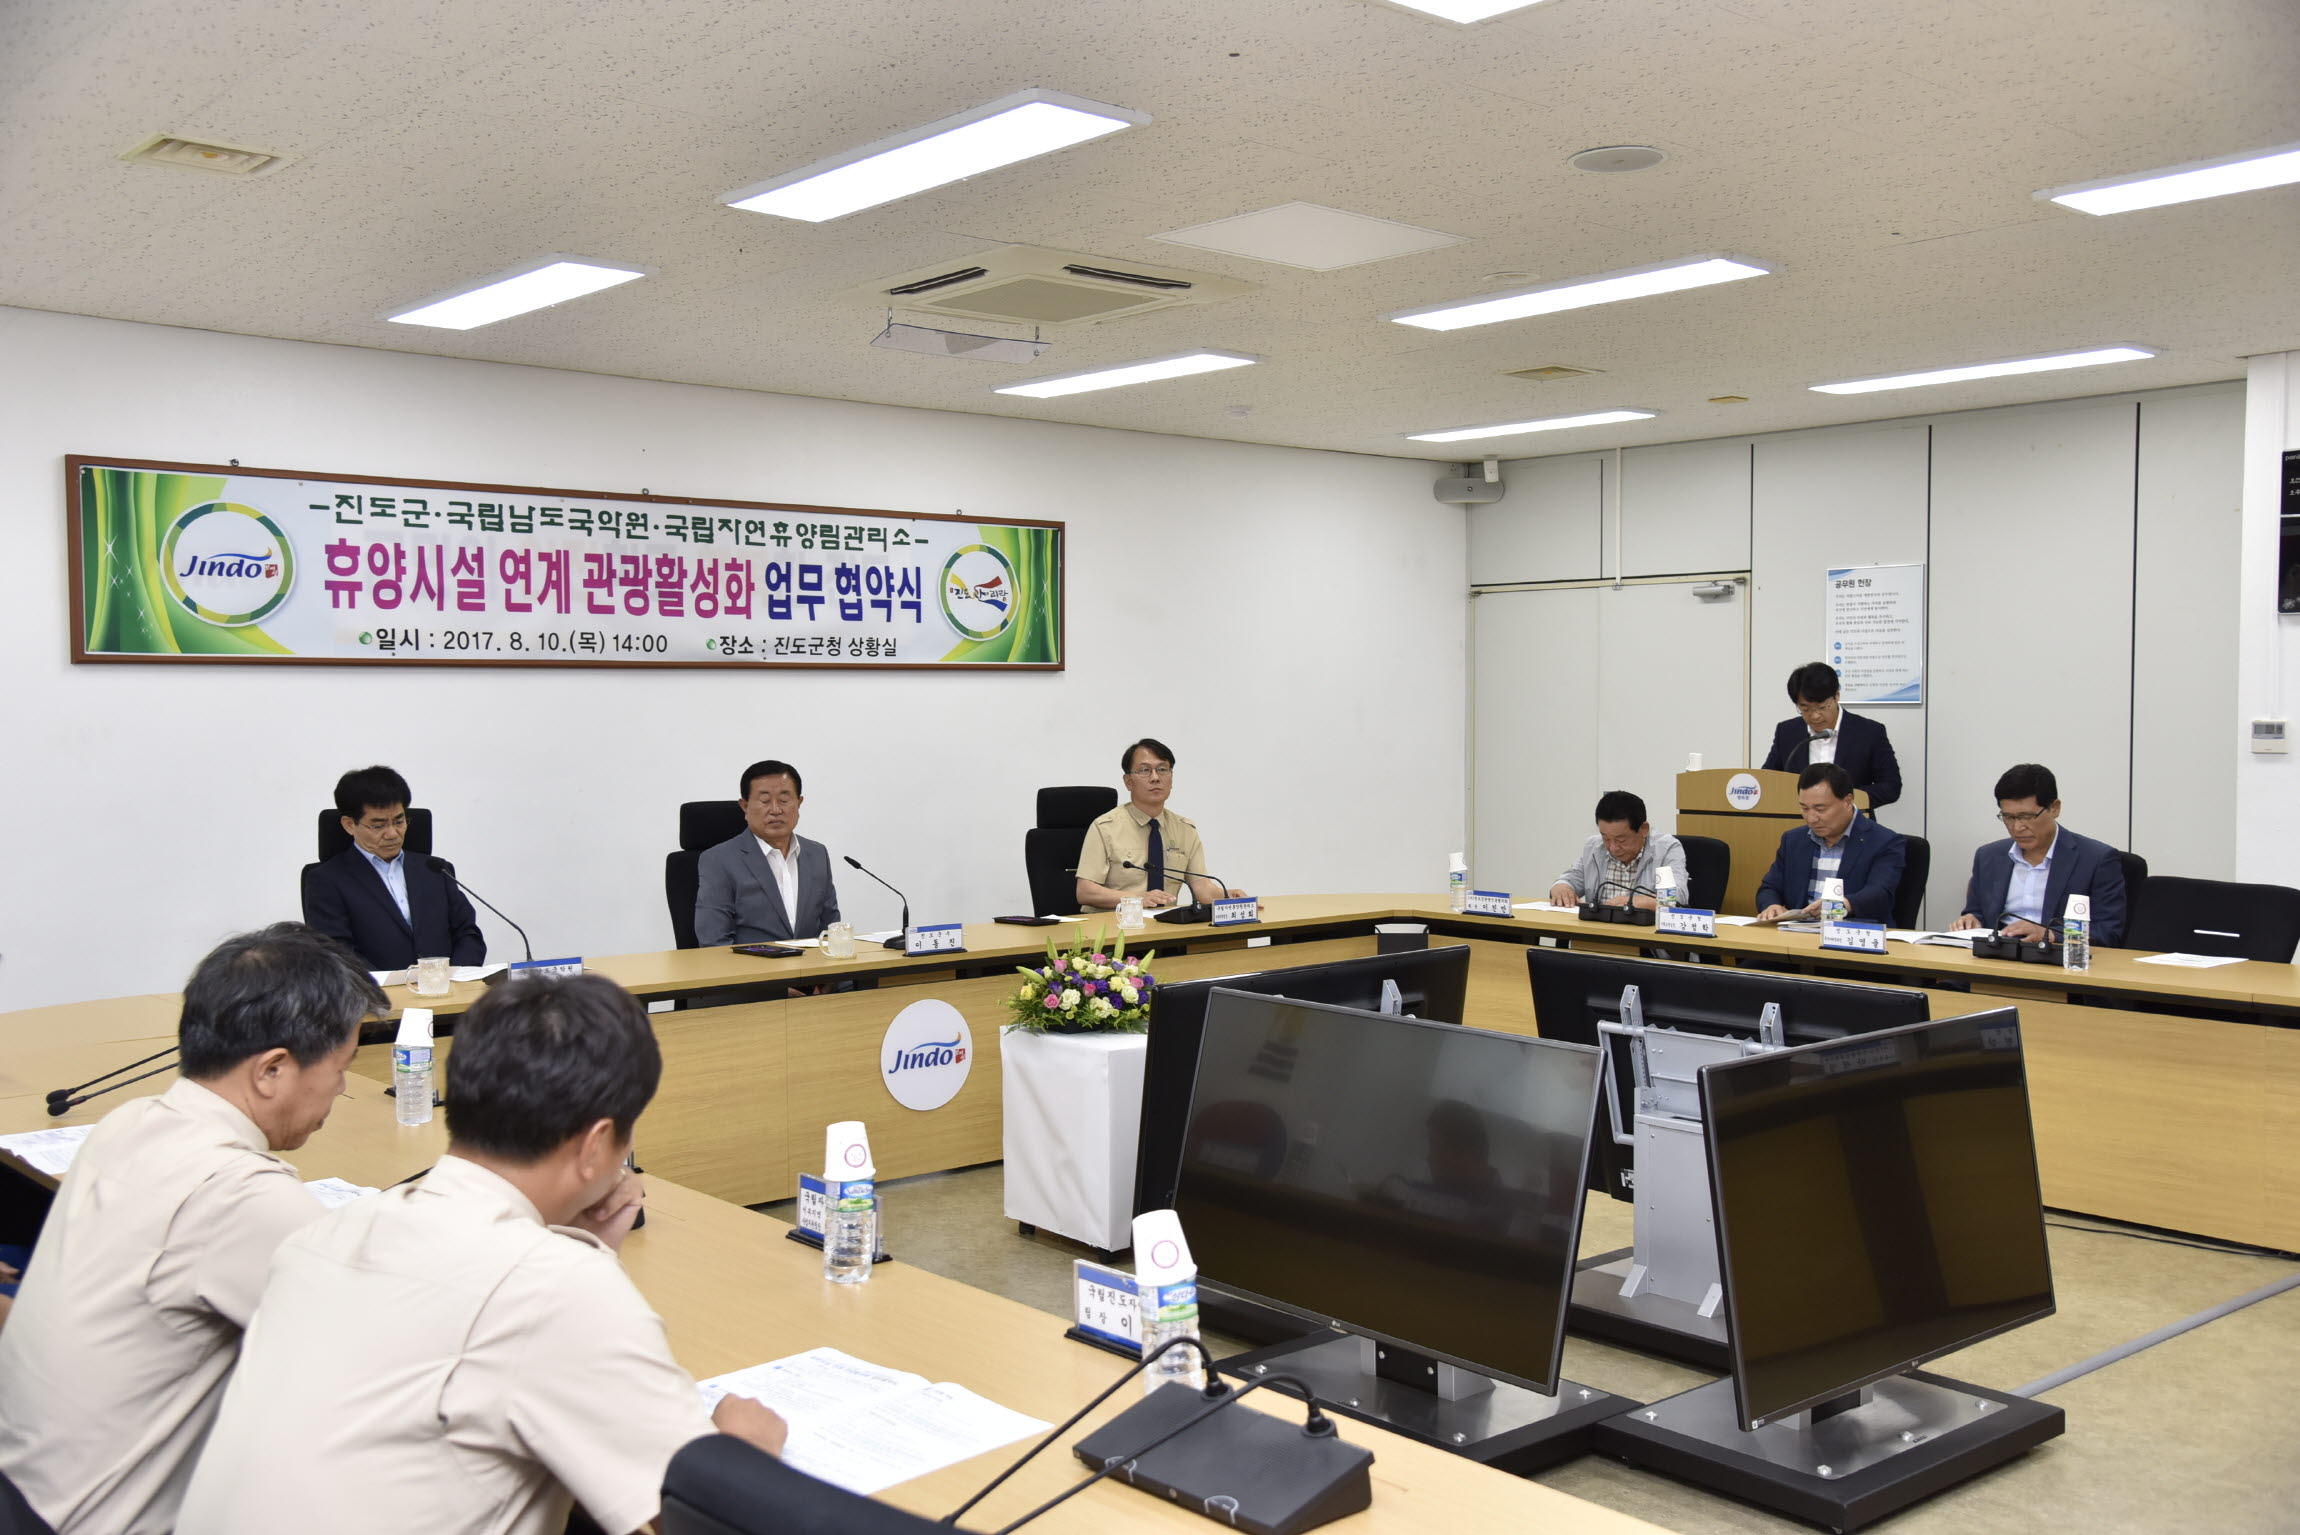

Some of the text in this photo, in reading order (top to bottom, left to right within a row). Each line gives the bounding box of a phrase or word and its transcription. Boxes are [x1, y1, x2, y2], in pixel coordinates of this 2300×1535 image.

[180, 555, 262, 579] Jindo
[324, 538, 922, 624] 휴양시설 연계 관광활성화 업무 협약식
[1835, 578, 1872, 588] 공무원 헌장
[376, 628, 420, 652] 일시
[443, 631, 501, 652] 2017.
[510, 632, 530, 652] 8.
[613, 633, 667, 653] 14:00
[720, 634, 755, 656] 장소
[773, 635, 842, 657] 진도군청
[848, 636, 897, 657] 상황실
[1729, 787, 1753, 795] Jindo
[888, 1047, 954, 1075] Jindo
[805, 1191, 825, 1207] 국립자
[1088, 1284, 1138, 1312] 국립진도자
